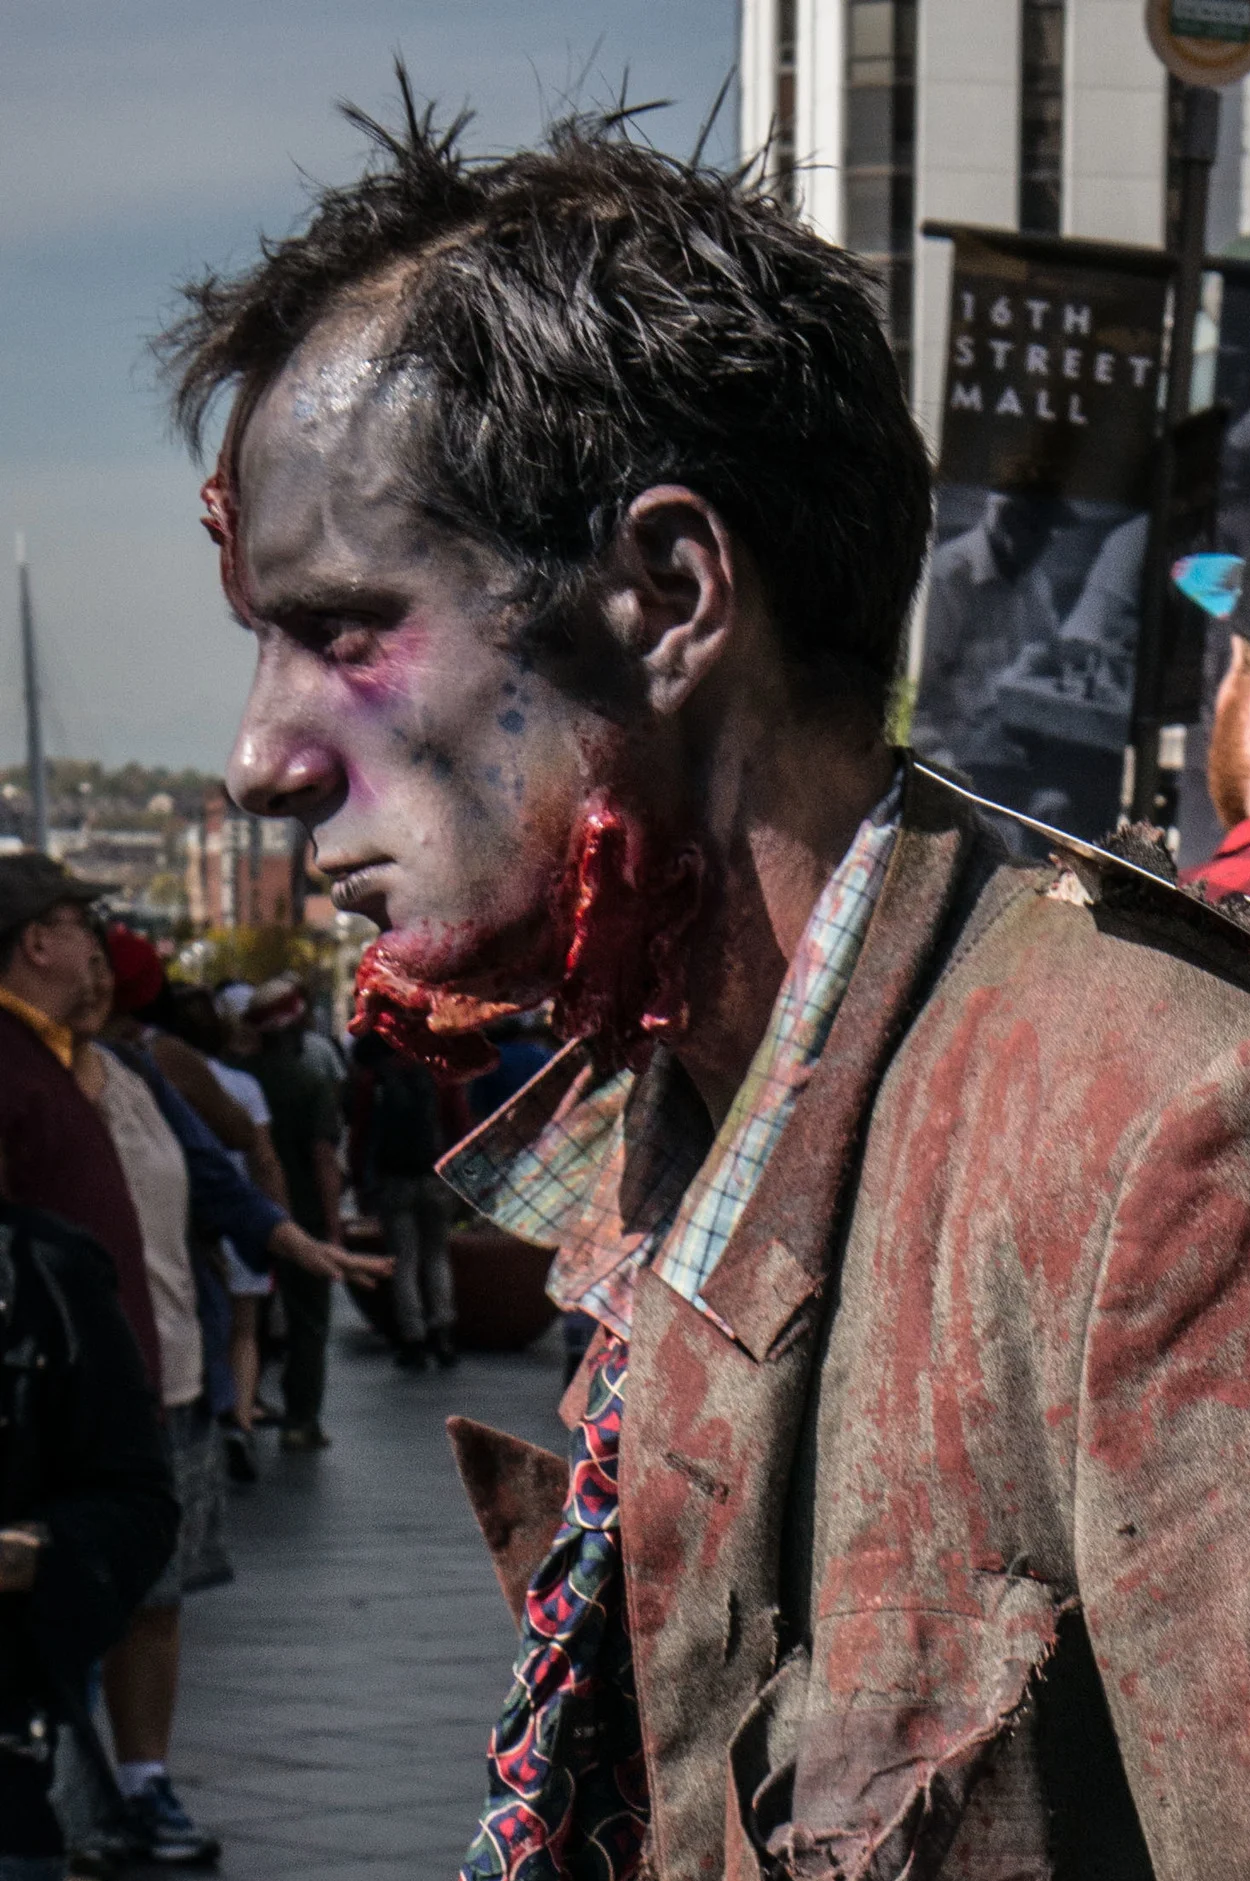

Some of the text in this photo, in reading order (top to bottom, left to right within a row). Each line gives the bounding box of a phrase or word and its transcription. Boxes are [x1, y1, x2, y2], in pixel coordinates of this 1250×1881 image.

[962, 291, 1092, 335] 16TH
[955, 335, 1153, 388] STREET
[951, 381, 1089, 425] MALL
